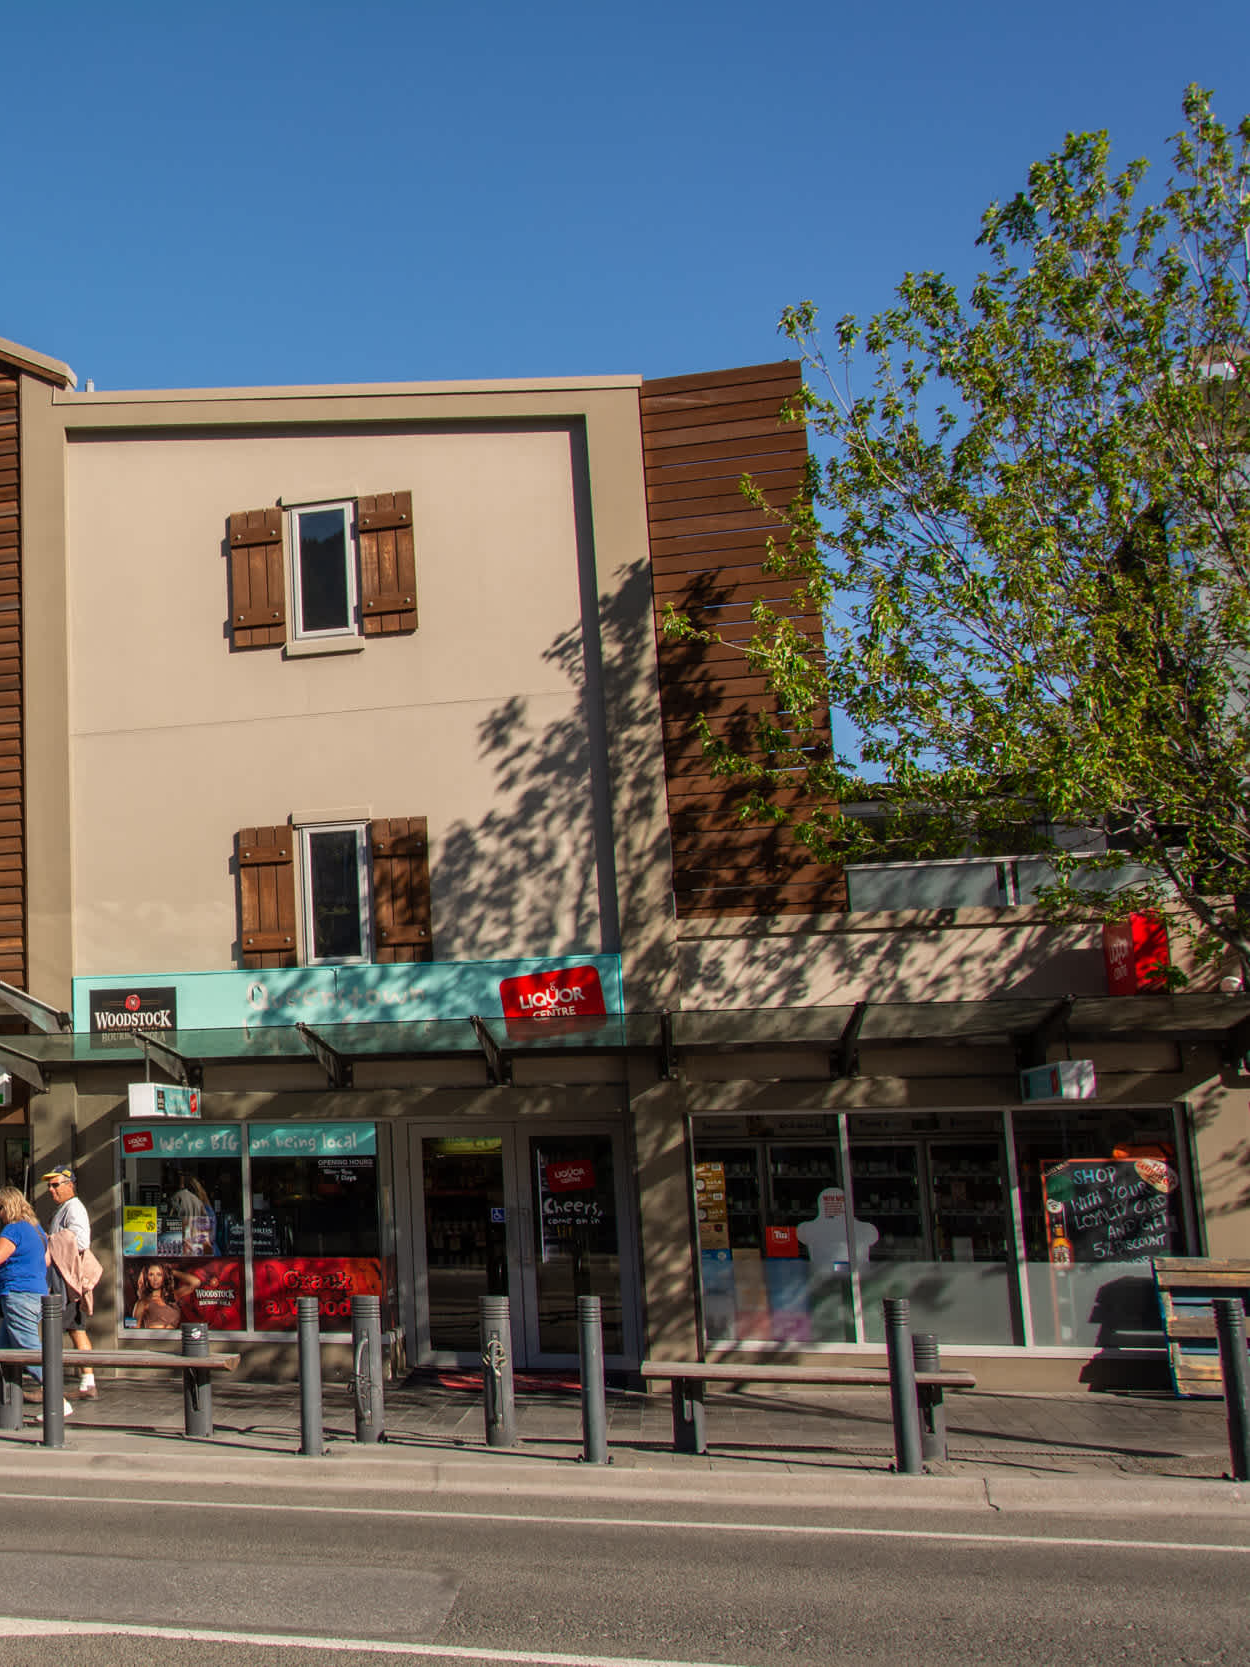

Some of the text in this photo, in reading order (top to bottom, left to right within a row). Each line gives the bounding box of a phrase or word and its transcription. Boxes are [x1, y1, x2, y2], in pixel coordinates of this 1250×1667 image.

[246, 981, 426, 1011] Queenstown
[519, 985, 586, 1010] LIQUOR
[94, 1010, 172, 1030] WOODSTOCK
[533, 1005, 577, 1021] CENTRE
[159, 1131, 358, 1152] We're BIG on being local
[349, 1158, 374, 1166] HOURS
[553, 1167, 585, 1179] LIQUOR
[1073, 1166, 1117, 1185] SHOP
[1070, 1181, 1150, 1212] WITH YOUR
[548, 1215, 601, 1225] come on in
[1075, 1194, 1167, 1230] LOYALTY CARD
[1141, 1208, 1168, 1232] GET
[283, 1270, 352, 1290] Crack
[195, 1288, 235, 1299] WOODSTOCK
[266, 1300, 280, 1315] a
